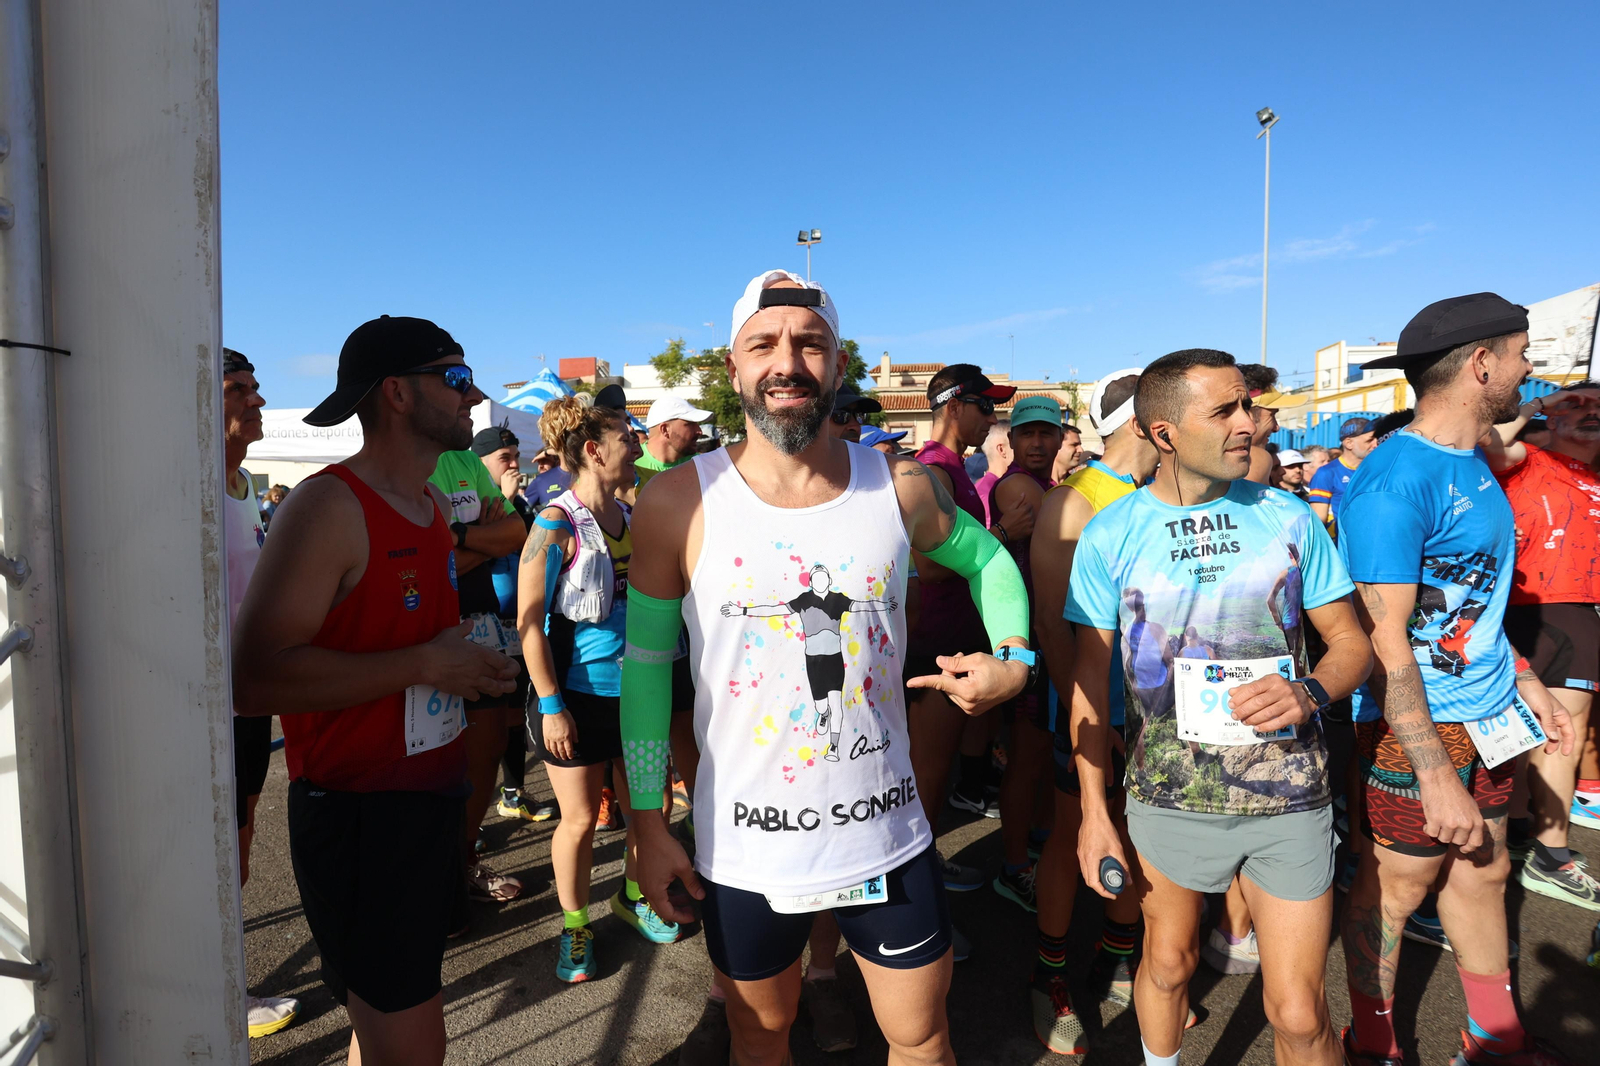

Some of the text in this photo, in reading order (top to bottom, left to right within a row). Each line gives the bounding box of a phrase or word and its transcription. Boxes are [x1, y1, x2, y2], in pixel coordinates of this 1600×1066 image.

[1165, 514, 1238, 538] TRAIL
[1177, 533, 1231, 547] Sierra de
[1170, 540, 1241, 562] FACINAS
[1193, 564, 1225, 575] octubre
[1197, 574, 1217, 583] 2023
[505, 630, 520, 642] 50
[734, 801, 821, 832] PABLO
